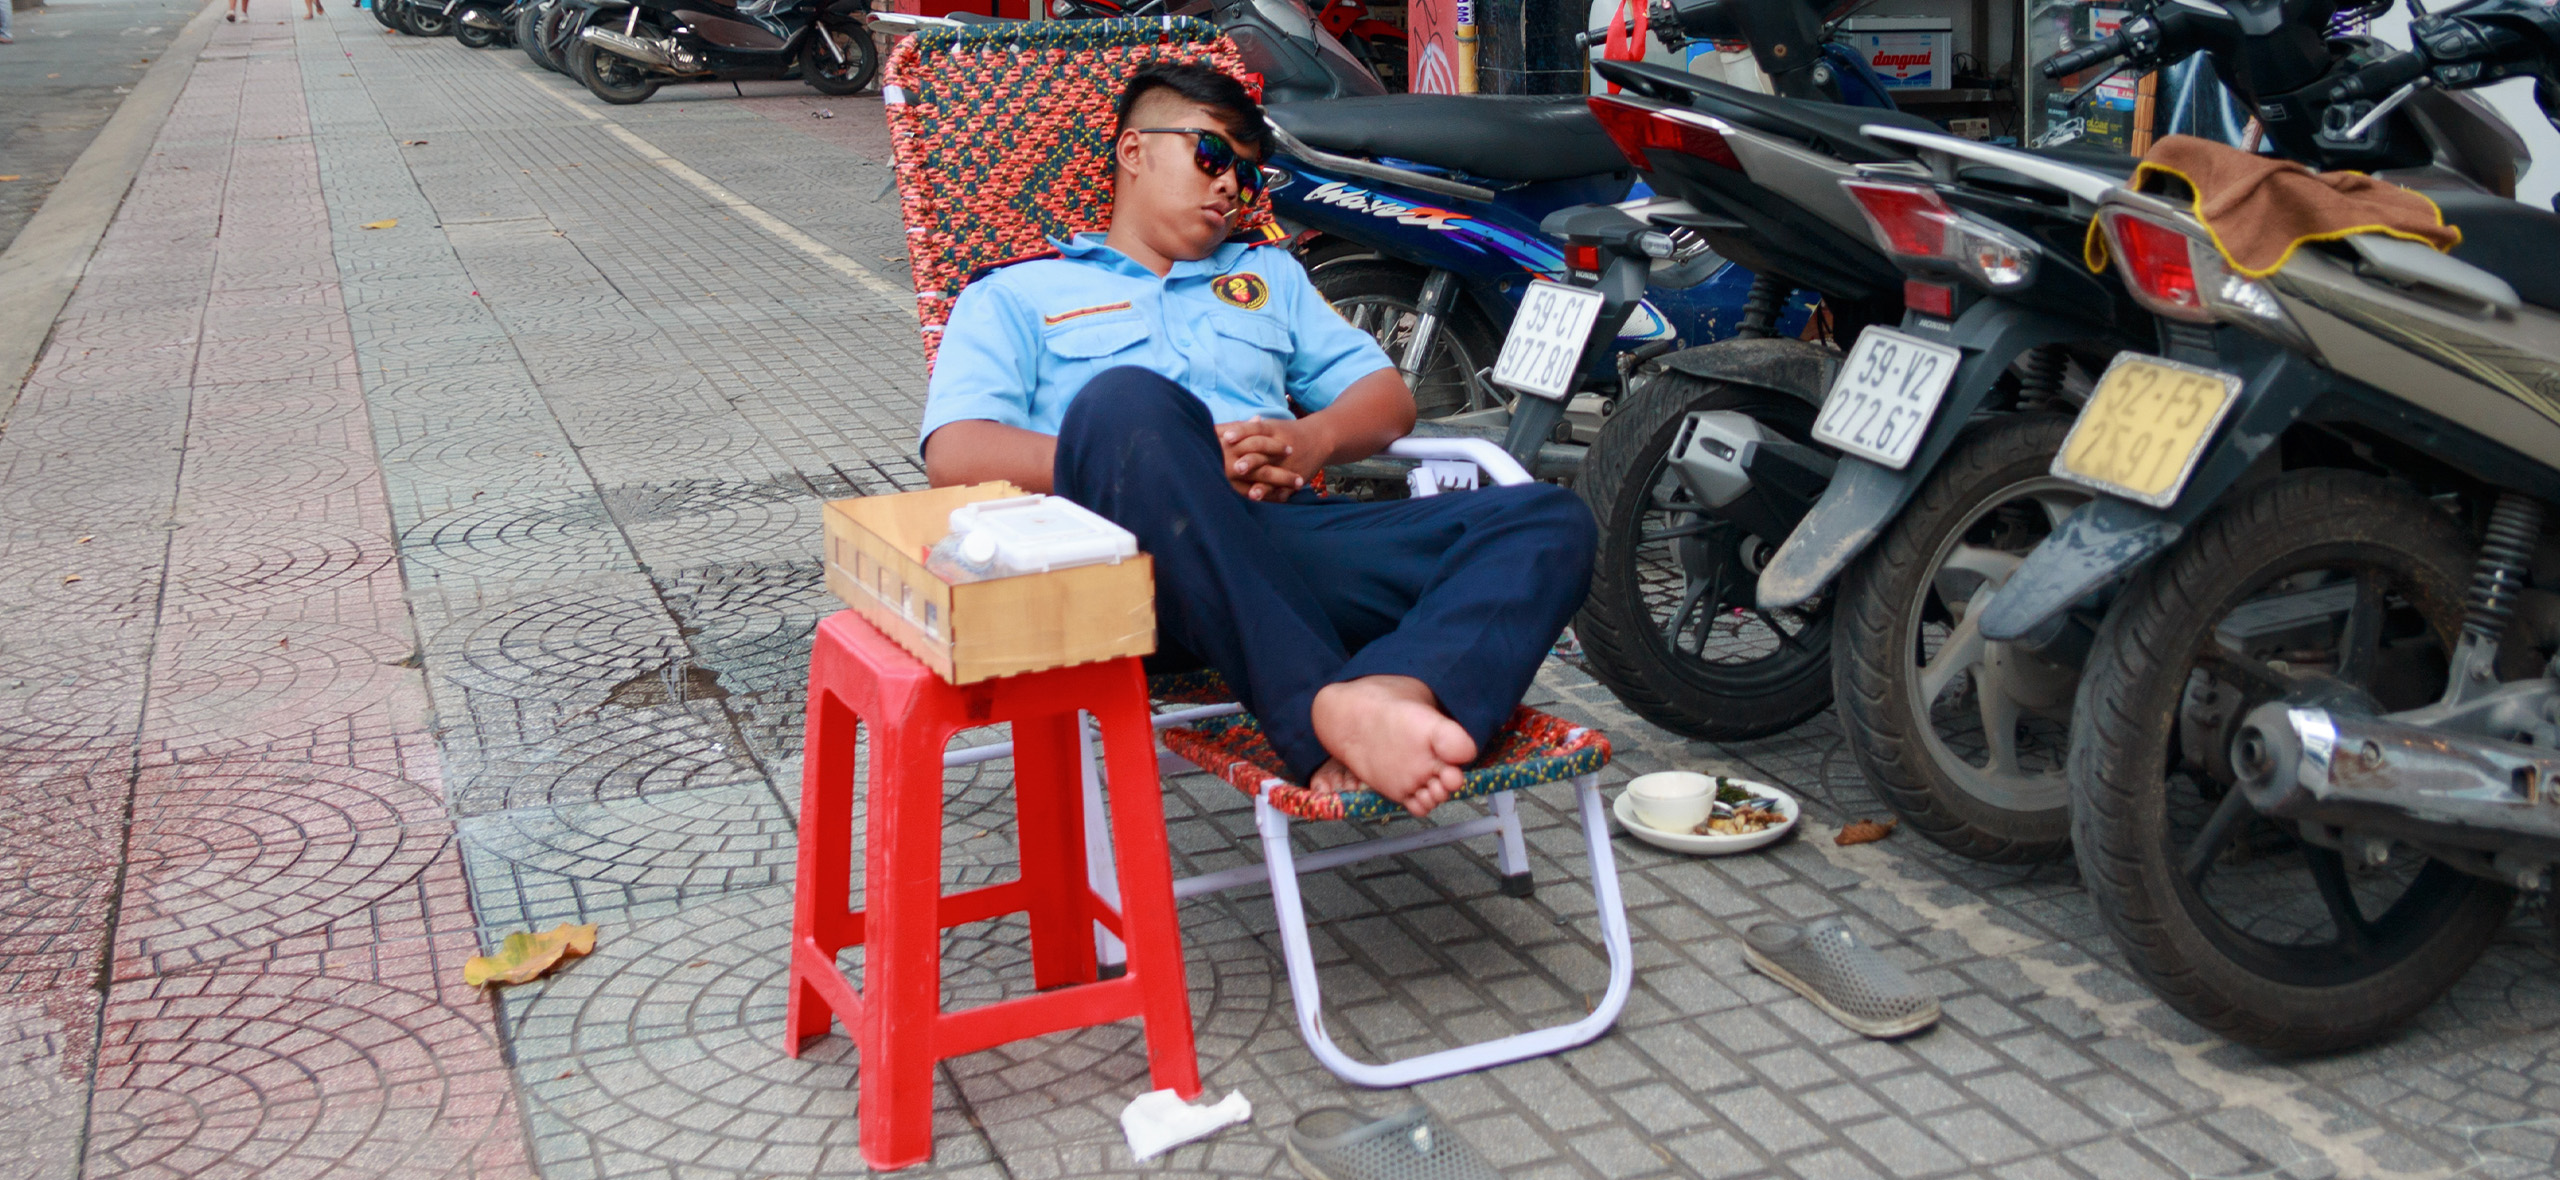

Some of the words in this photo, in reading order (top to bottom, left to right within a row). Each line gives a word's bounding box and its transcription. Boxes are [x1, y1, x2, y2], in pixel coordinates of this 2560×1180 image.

[1575, 270, 1599, 281] HONDA
[1526, 291, 1586, 340] 59-C1
[1918, 318, 1950, 332] HONDA
[1501, 335, 1574, 388] 977.80
[1858, 340, 1938, 402] 59-V2
[1822, 388, 1922, 455] 272.67
